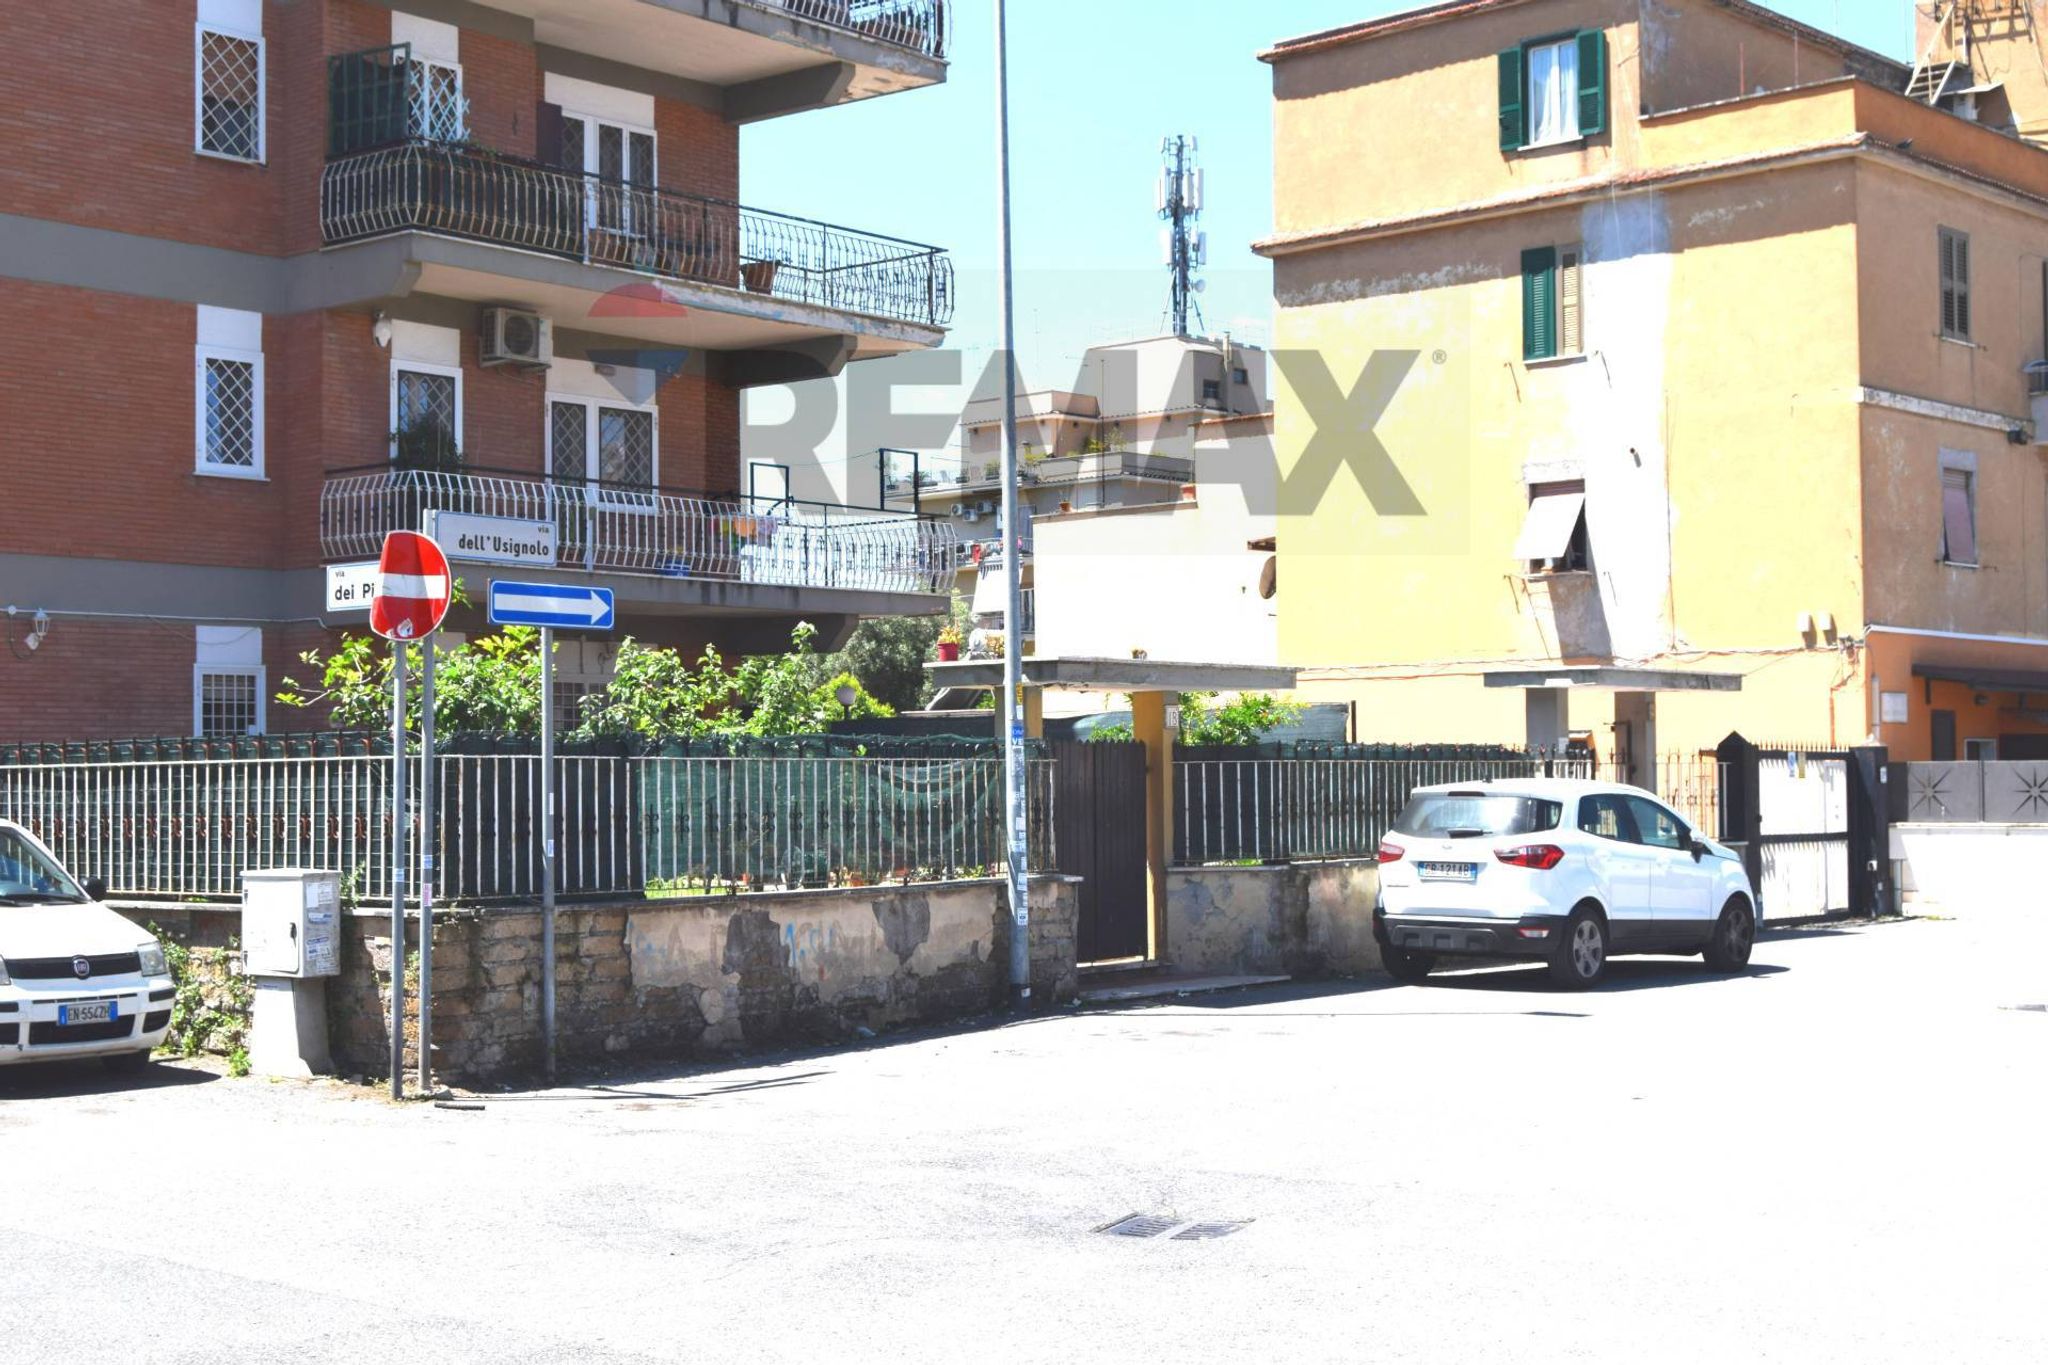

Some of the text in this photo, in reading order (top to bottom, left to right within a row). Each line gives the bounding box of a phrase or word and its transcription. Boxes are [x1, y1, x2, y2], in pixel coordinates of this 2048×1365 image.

[538, 525, 550, 533] via
[458, 534, 549, 557] dell'Usignolo
[335, 570, 345, 578] via
[334, 582, 375, 601] dei Pi
